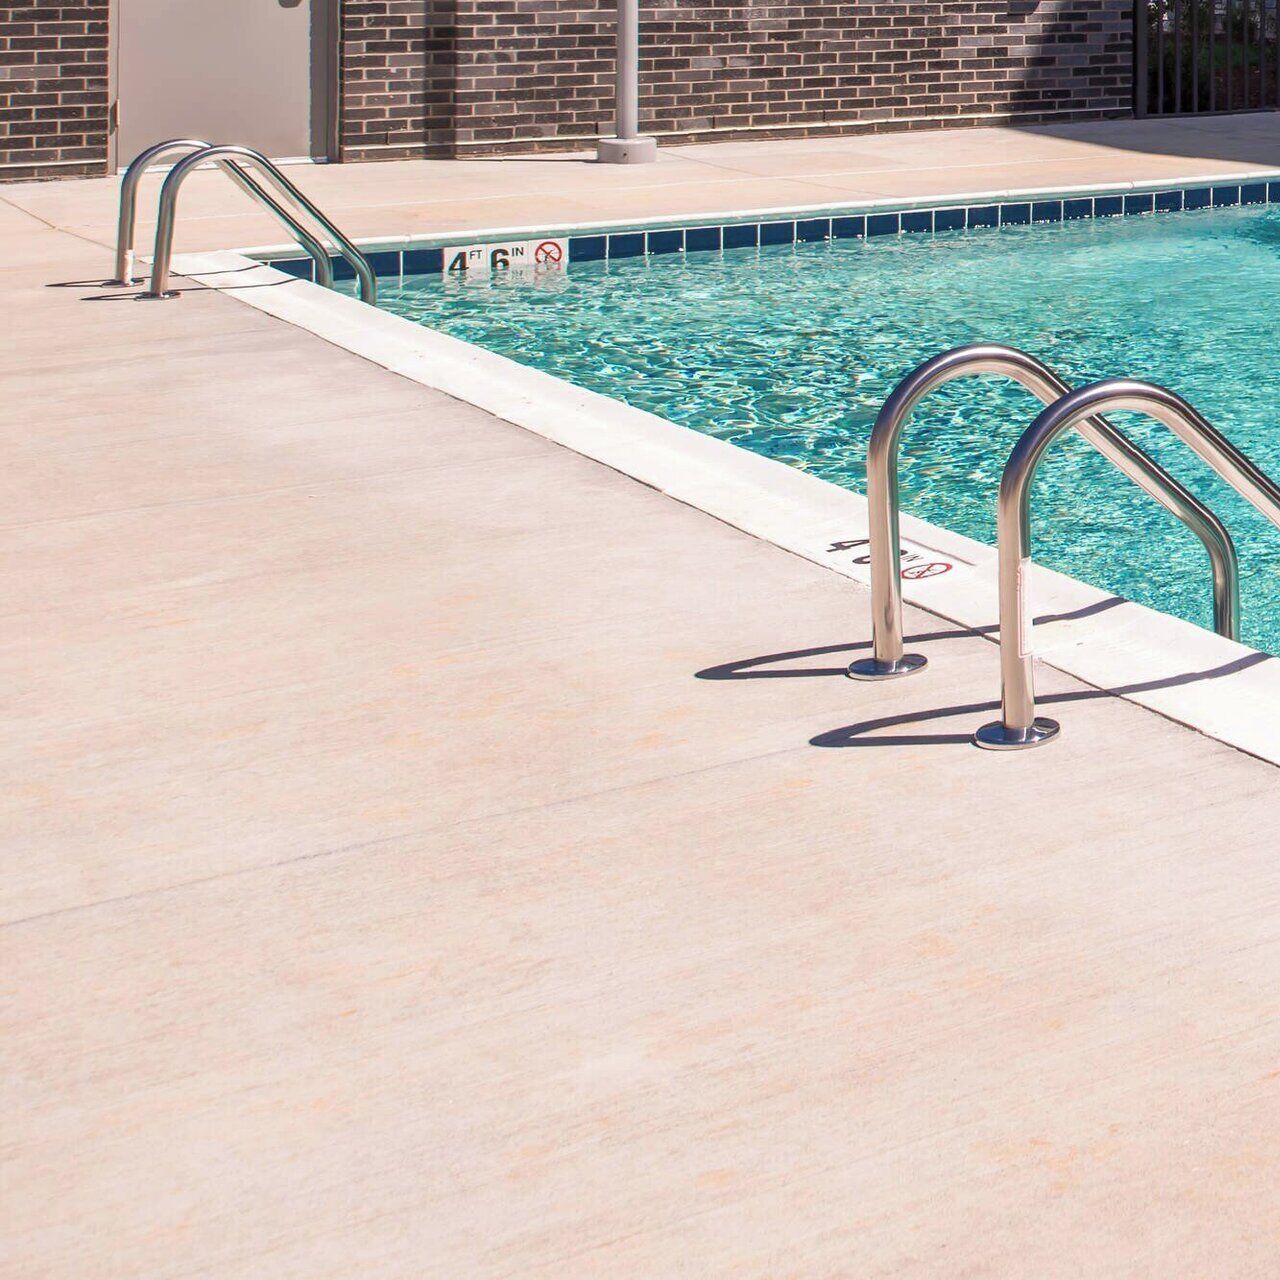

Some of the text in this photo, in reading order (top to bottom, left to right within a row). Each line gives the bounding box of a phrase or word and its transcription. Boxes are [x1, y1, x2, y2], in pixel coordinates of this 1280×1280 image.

[448, 247, 524, 271] 4 FT 6 IN
